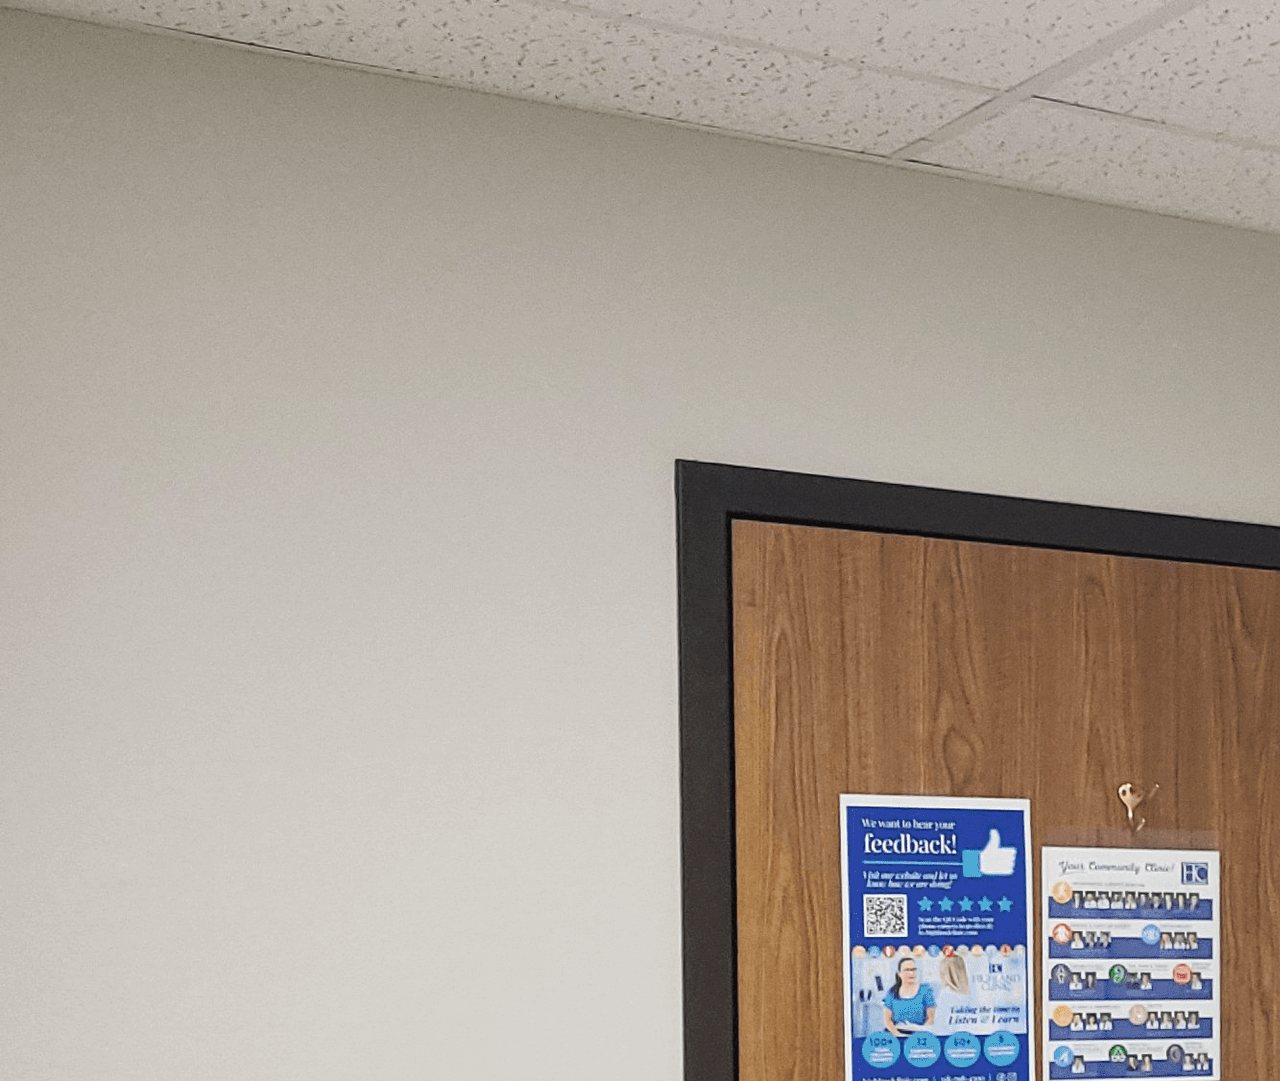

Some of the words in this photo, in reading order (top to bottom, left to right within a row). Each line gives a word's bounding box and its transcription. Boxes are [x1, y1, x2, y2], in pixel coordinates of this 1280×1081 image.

[861, 818, 877, 828] We
[879, 820, 901, 829] want
[902, 820, 912, 830] to
[914, 819, 934, 830] hear
[864, 833, 957, 855] feedback!
